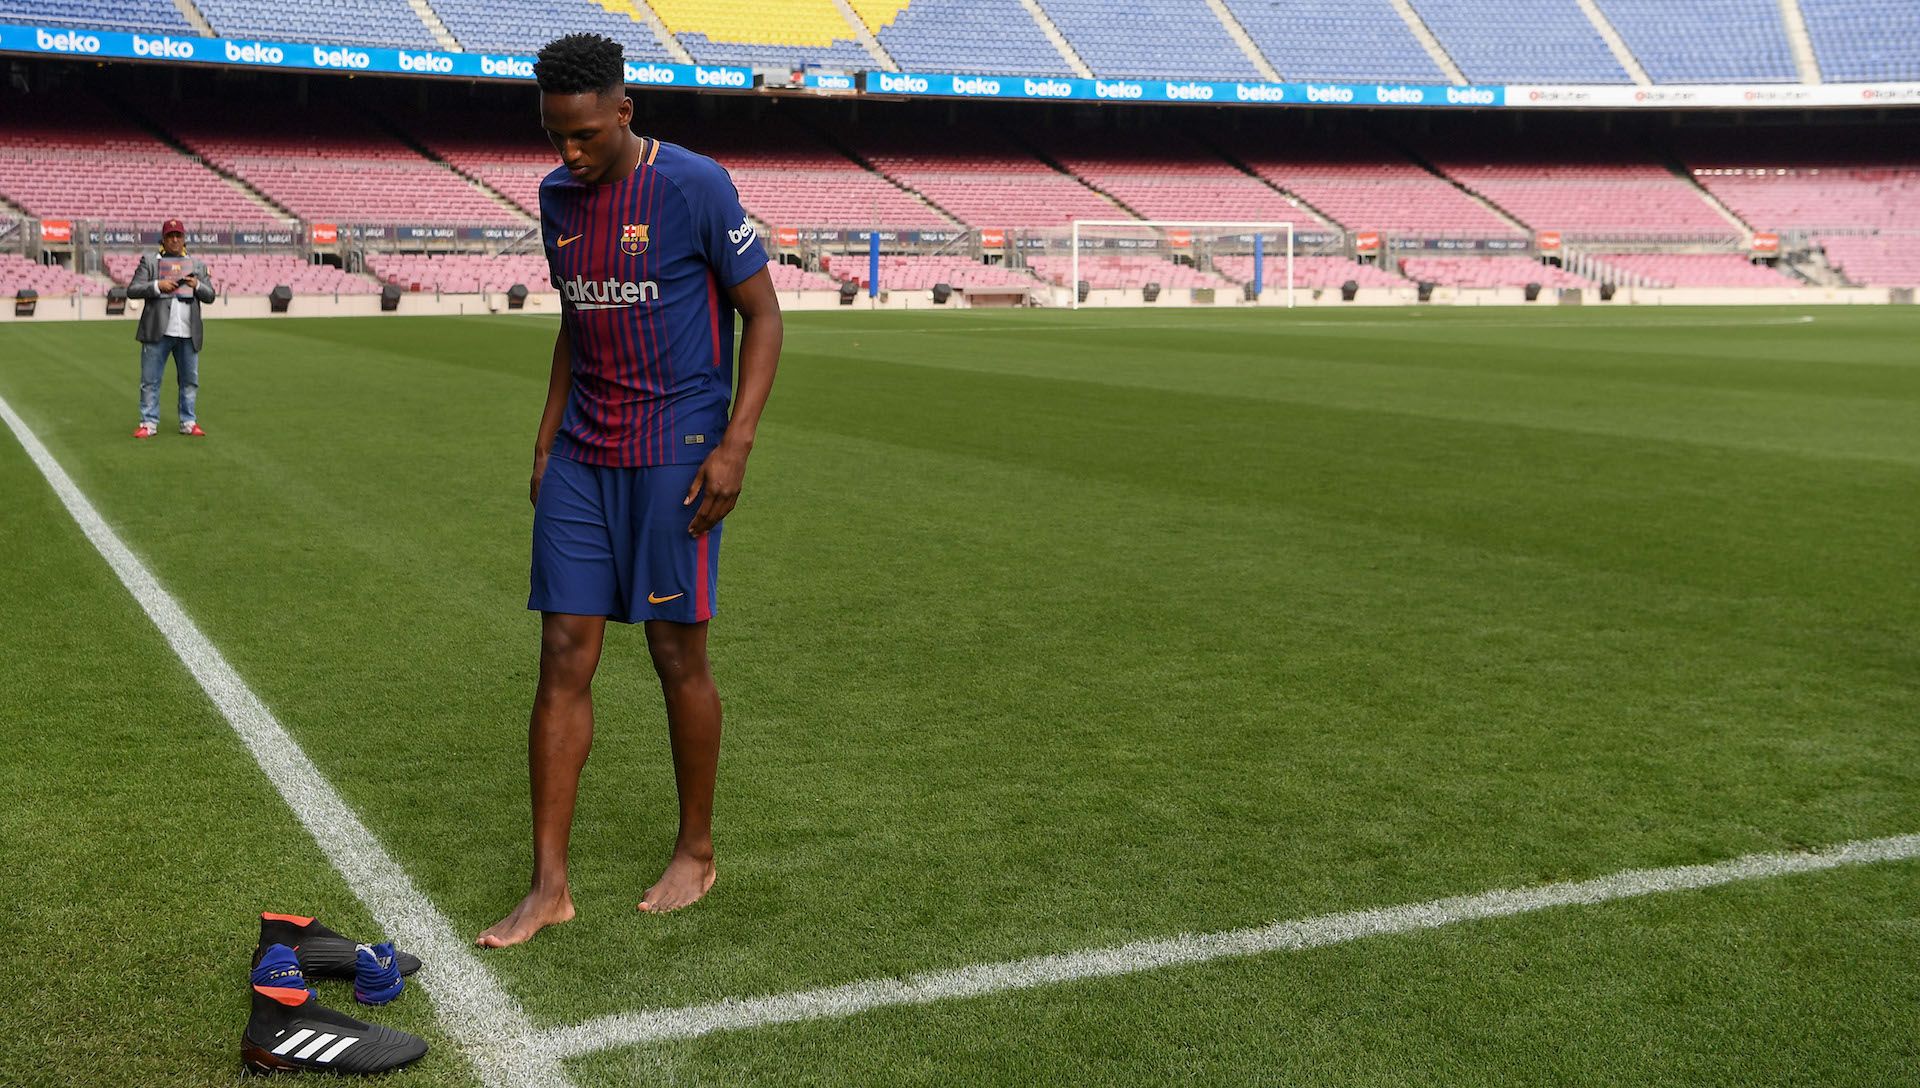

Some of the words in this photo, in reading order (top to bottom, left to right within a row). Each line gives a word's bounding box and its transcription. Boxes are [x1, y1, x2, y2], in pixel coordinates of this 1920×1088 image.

[36, 28, 101, 53] beko
[132, 35, 194, 59] beko
[226, 40, 284, 64] beko
[313, 46, 370, 69] beko
[398, 50, 454, 73] beko
[480, 56, 535, 77] beko
[624, 63, 674, 84] beko
[695, 66, 746, 87] beko
[817, 76, 850, 88] beko
[880, 73, 928, 93] beko
[952, 75, 1000, 95] beko
[1024, 78, 1072, 97] beko
[1095, 80, 1143, 98] beko
[1166, 81, 1214, 100] beko
[1236, 83, 1284, 101] beko
[1306, 85, 1354, 102] beko
[1376, 86, 1424, 103] beko
[1446, 87, 1495, 104] beko
[728, 214, 755, 244] bek
